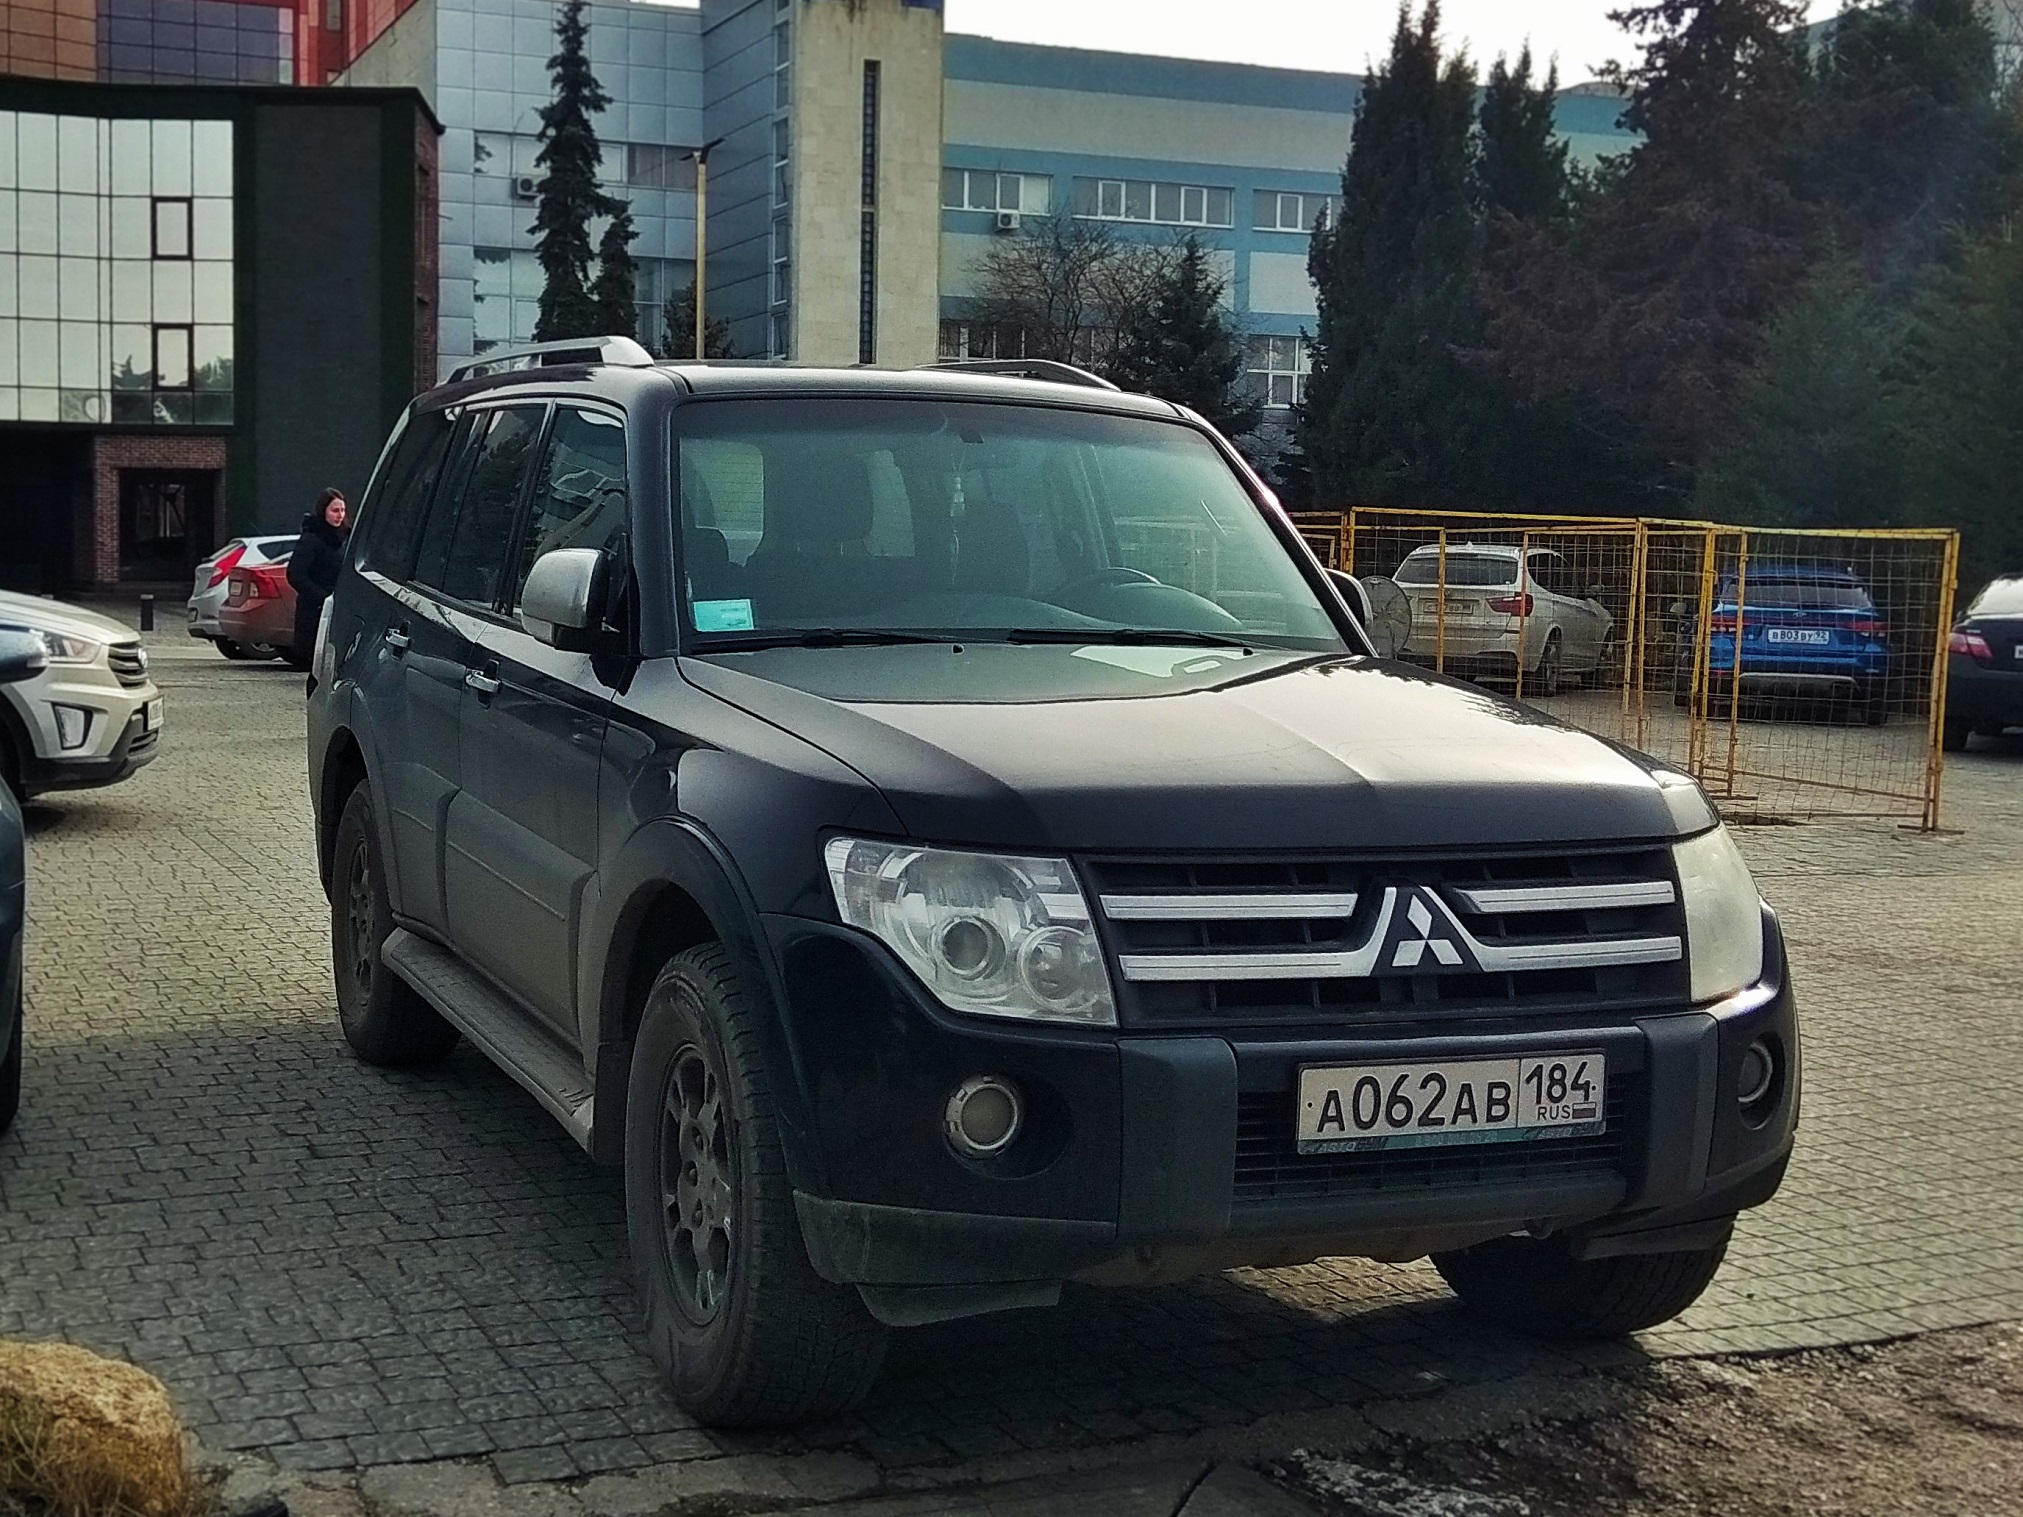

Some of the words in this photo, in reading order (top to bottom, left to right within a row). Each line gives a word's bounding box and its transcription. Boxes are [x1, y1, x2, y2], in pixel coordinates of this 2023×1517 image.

[1317, 1072, 1512, 1133] А062АВ
[1526, 1061, 1591, 1105] 184
[1537, 1104, 1571, 1120] RUS
